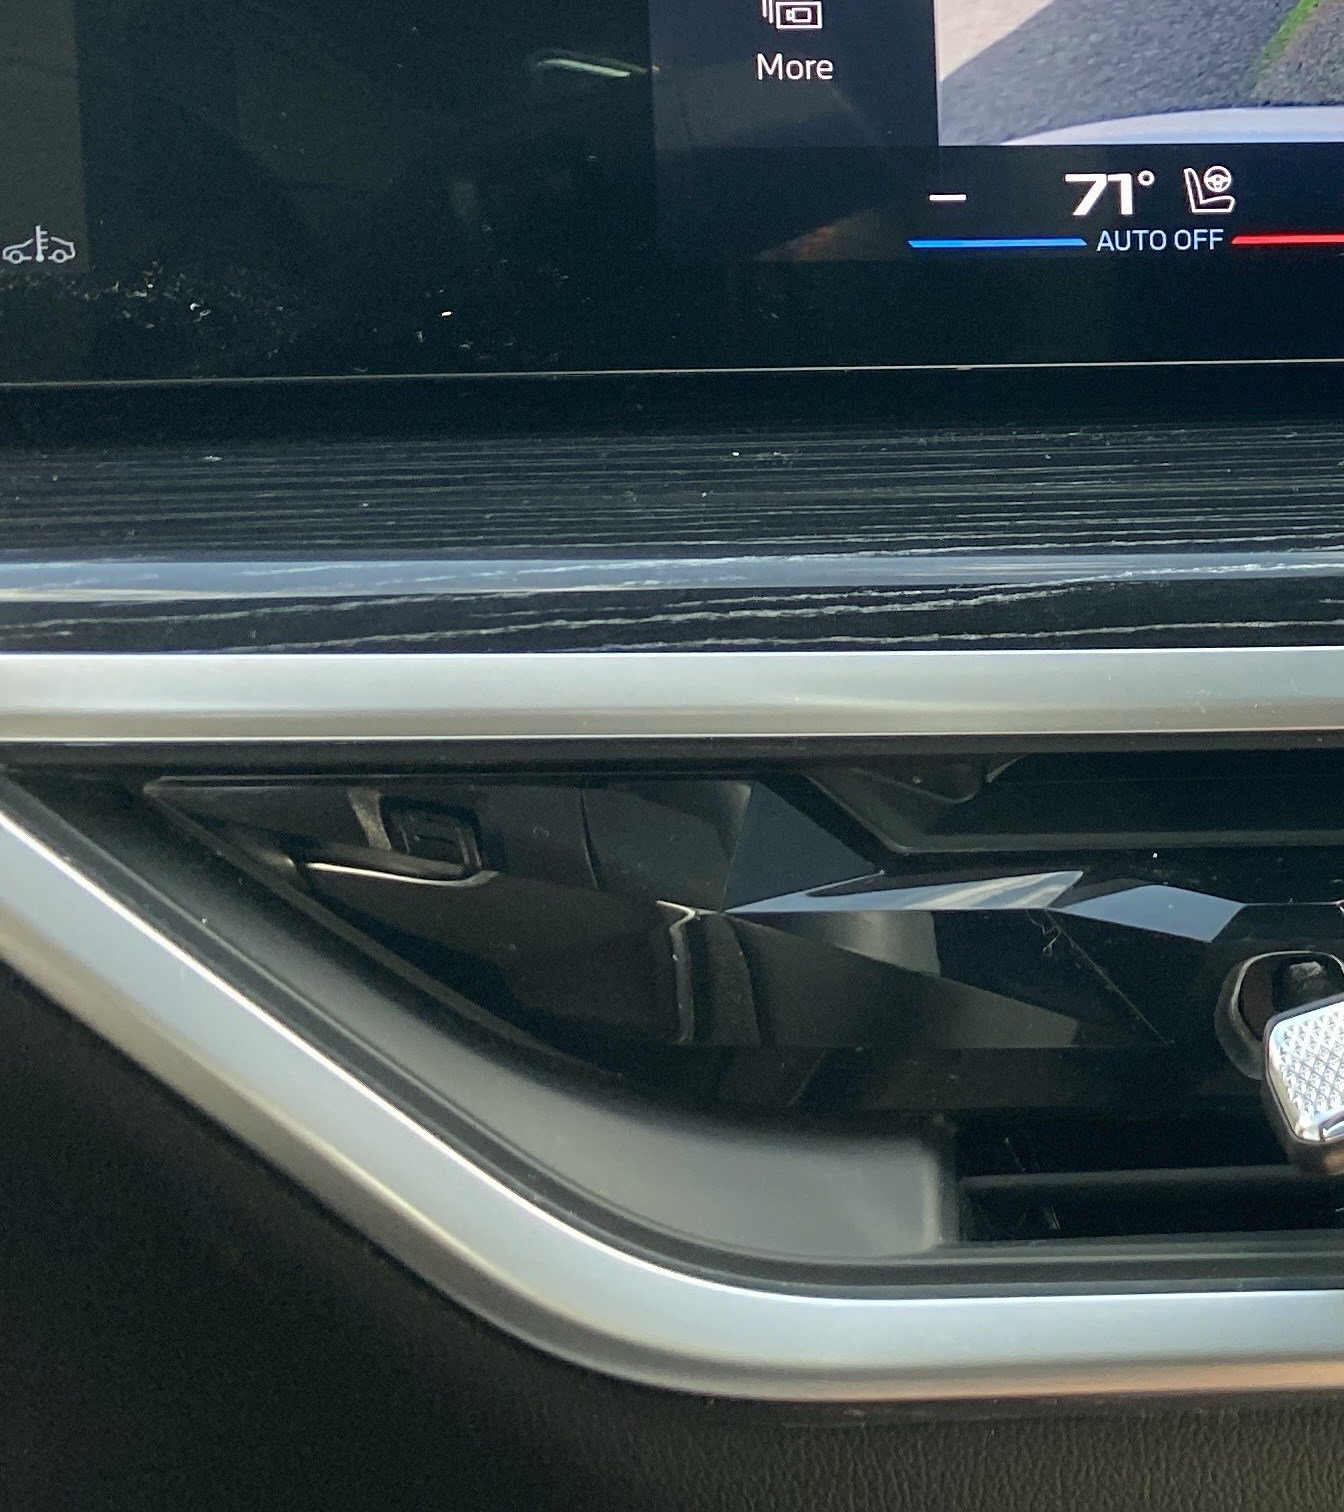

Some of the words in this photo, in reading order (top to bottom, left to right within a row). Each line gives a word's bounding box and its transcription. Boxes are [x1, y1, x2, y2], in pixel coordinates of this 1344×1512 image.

[756, 52, 835, 82] More
[1096, 228, 1168, 253] AUTO
[1173, 227, 1225, 252] OFF
